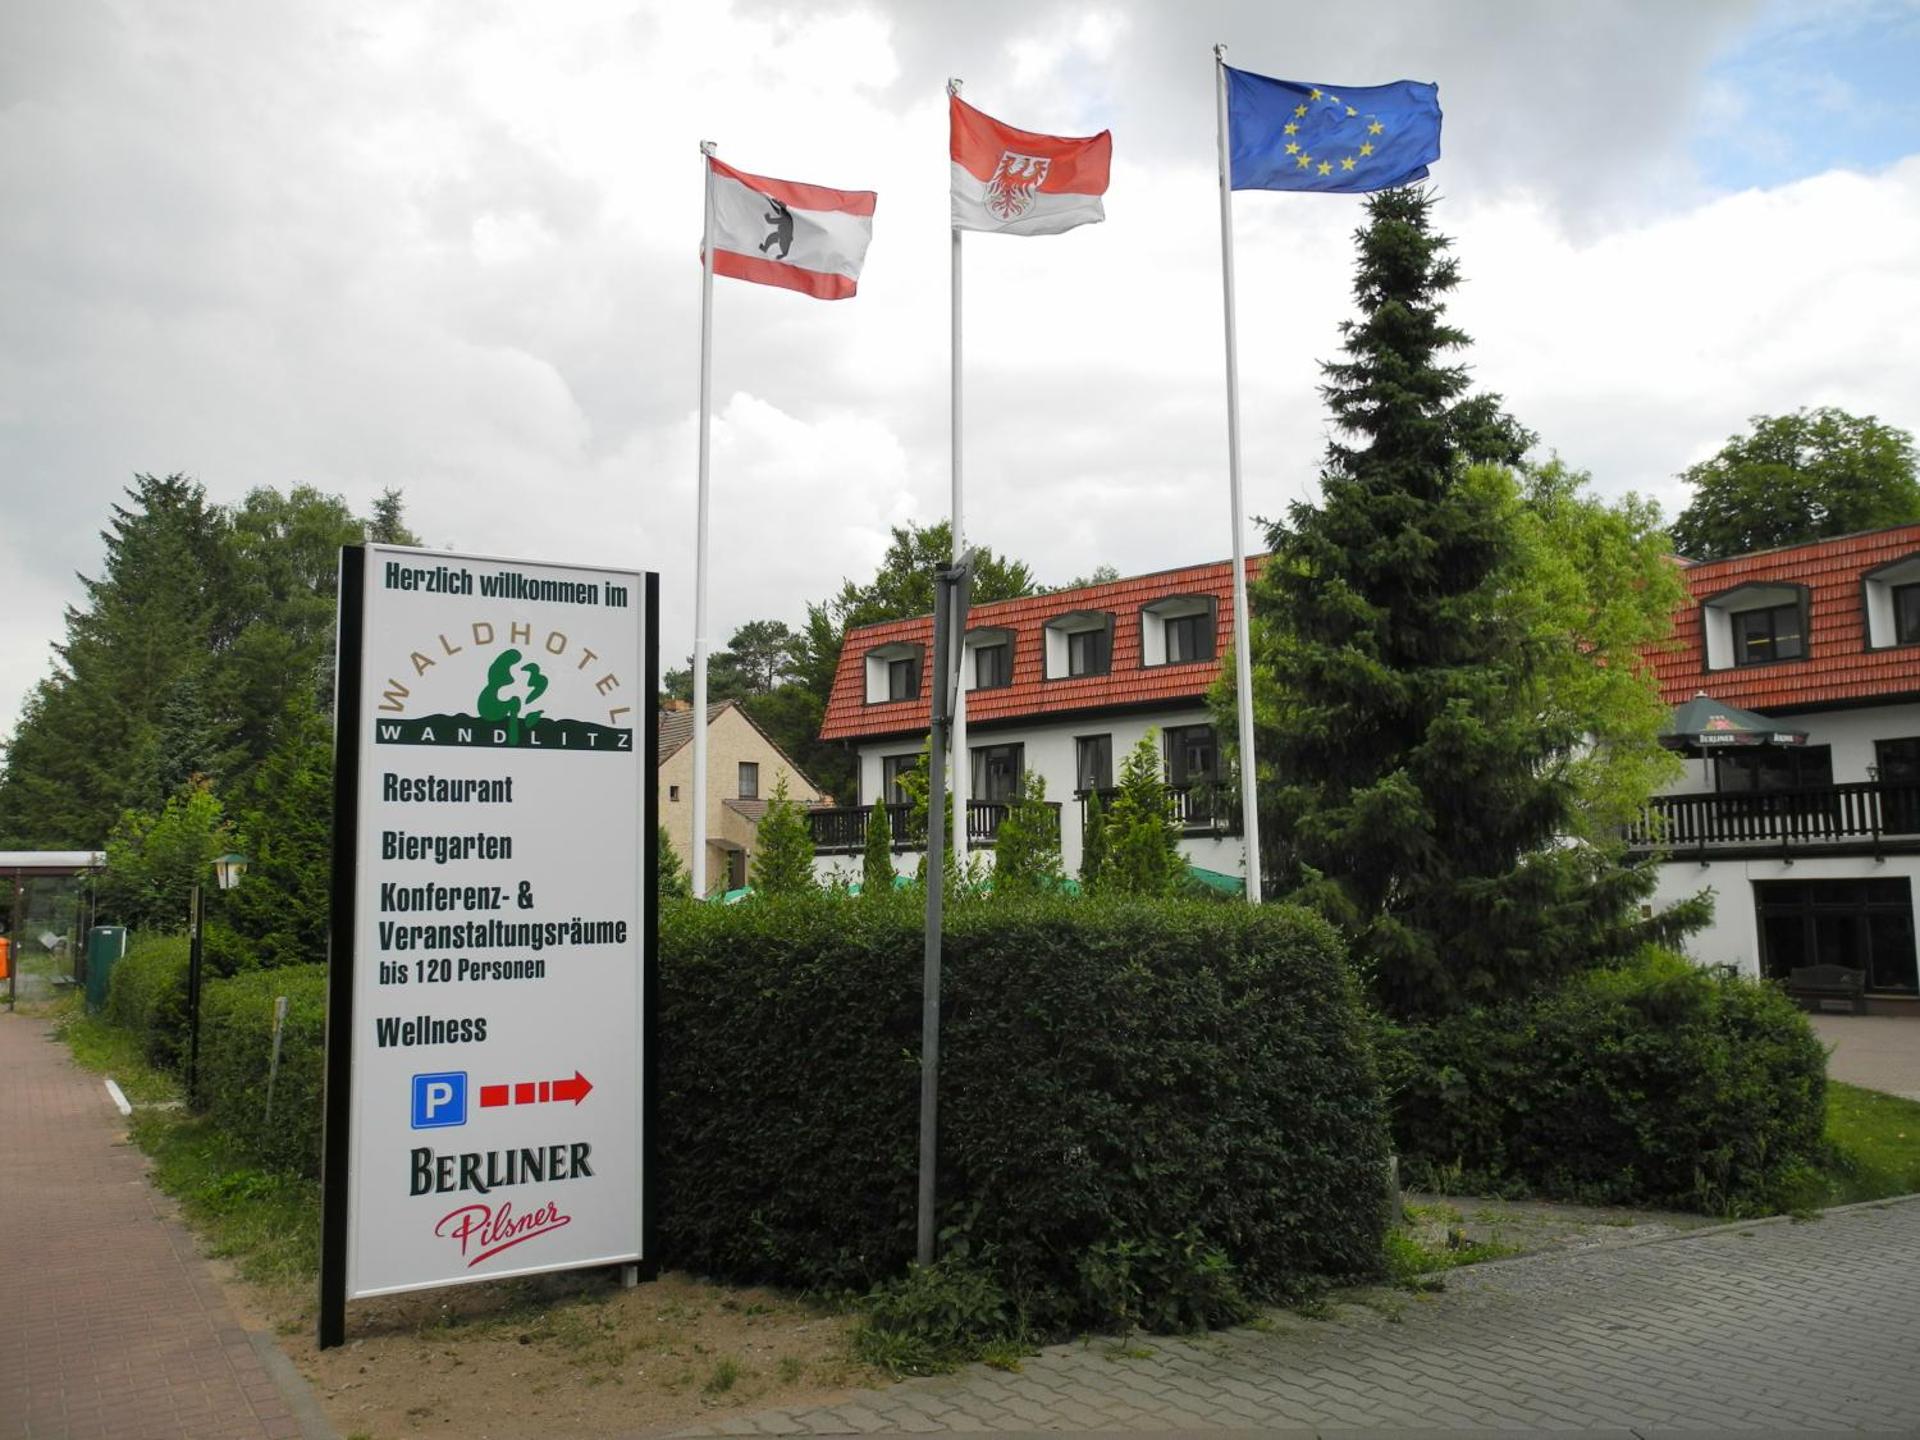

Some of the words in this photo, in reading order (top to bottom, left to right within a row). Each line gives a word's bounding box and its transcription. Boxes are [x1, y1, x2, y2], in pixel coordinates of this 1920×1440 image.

[385, 561, 473, 596] Herzlich
[480, 572, 599, 605] willkommen
[605, 581, 628, 607] im
[378, 621, 630, 724] WALDHOTEL
[381, 725, 629, 748] WANDLITZ
[383, 772, 513, 803] Restaurant
[381, 830, 512, 864] Biergarten
[380, 882, 510, 912] Konferenz-
[517, 880, 534, 910] &
[378, 917, 627, 951] Veranstaltungsräume
[379, 960, 408, 985] bis
[415, 959, 452, 983] 120
[457, 959, 545, 982] Personen
[376, 1015, 487, 1047] Wellness
[426, 1082, 452, 1119] P
[409, 1142, 594, 1196] BERLINER
[434, 1201, 571, 1268] Pilsner
